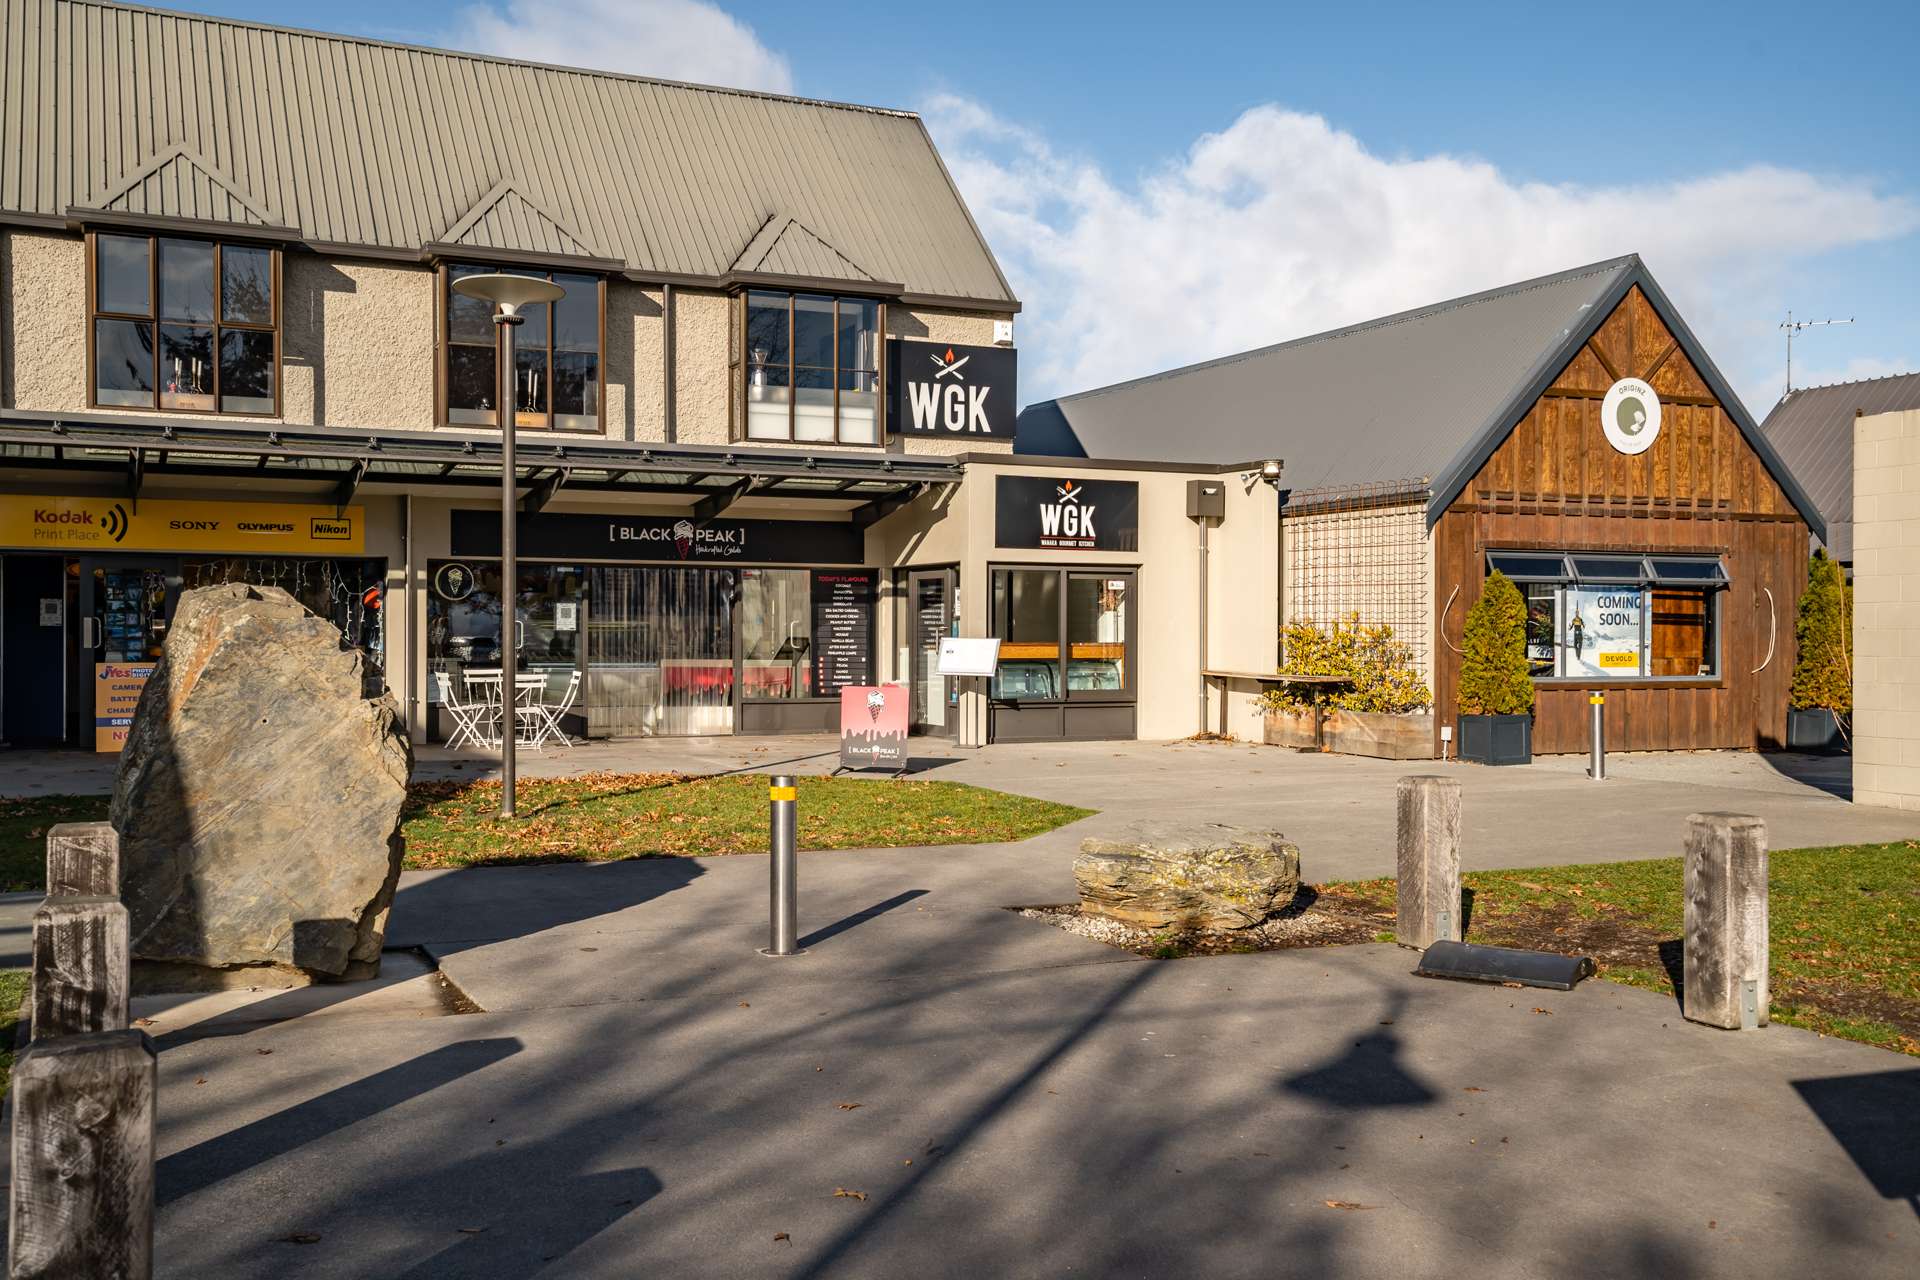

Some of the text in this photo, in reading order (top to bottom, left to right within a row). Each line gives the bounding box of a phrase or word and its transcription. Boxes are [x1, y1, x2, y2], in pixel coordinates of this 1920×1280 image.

[1618, 384, 1647, 396] ORIGINZ
[908, 381, 992, 433] WGK
[34, 509, 93, 525] Kodak
[1040, 503, 1096, 537] WGK
[169, 520, 220, 531] SONY
[237, 522, 295, 532] OLYMPUS
[314, 524, 348, 534] Nikon
[33, 528, 100, 541] Print Place
[620, 527, 736, 543] BLACK PEAK
